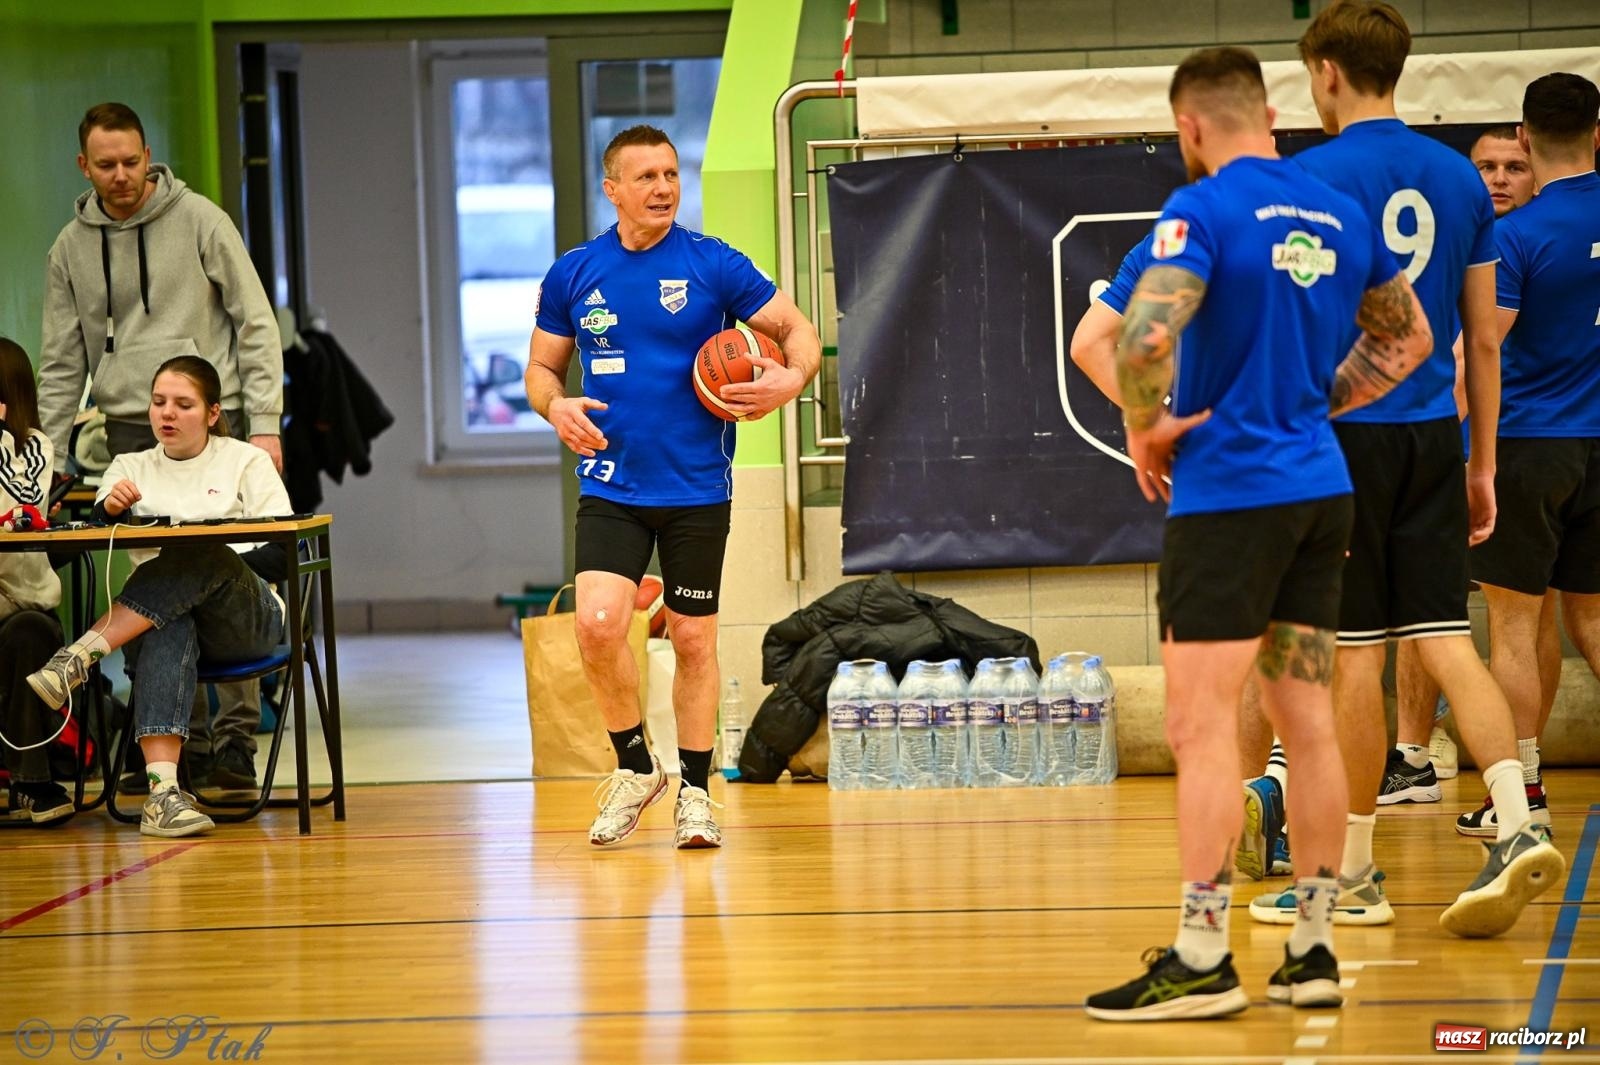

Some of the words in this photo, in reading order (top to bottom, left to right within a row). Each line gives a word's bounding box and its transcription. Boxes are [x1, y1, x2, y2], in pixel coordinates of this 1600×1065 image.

[1382, 188, 1436, 285] 9
[593, 337, 611, 348] VR
[724, 342, 736, 361] FIBA
[703, 346, 719, 382] molten
